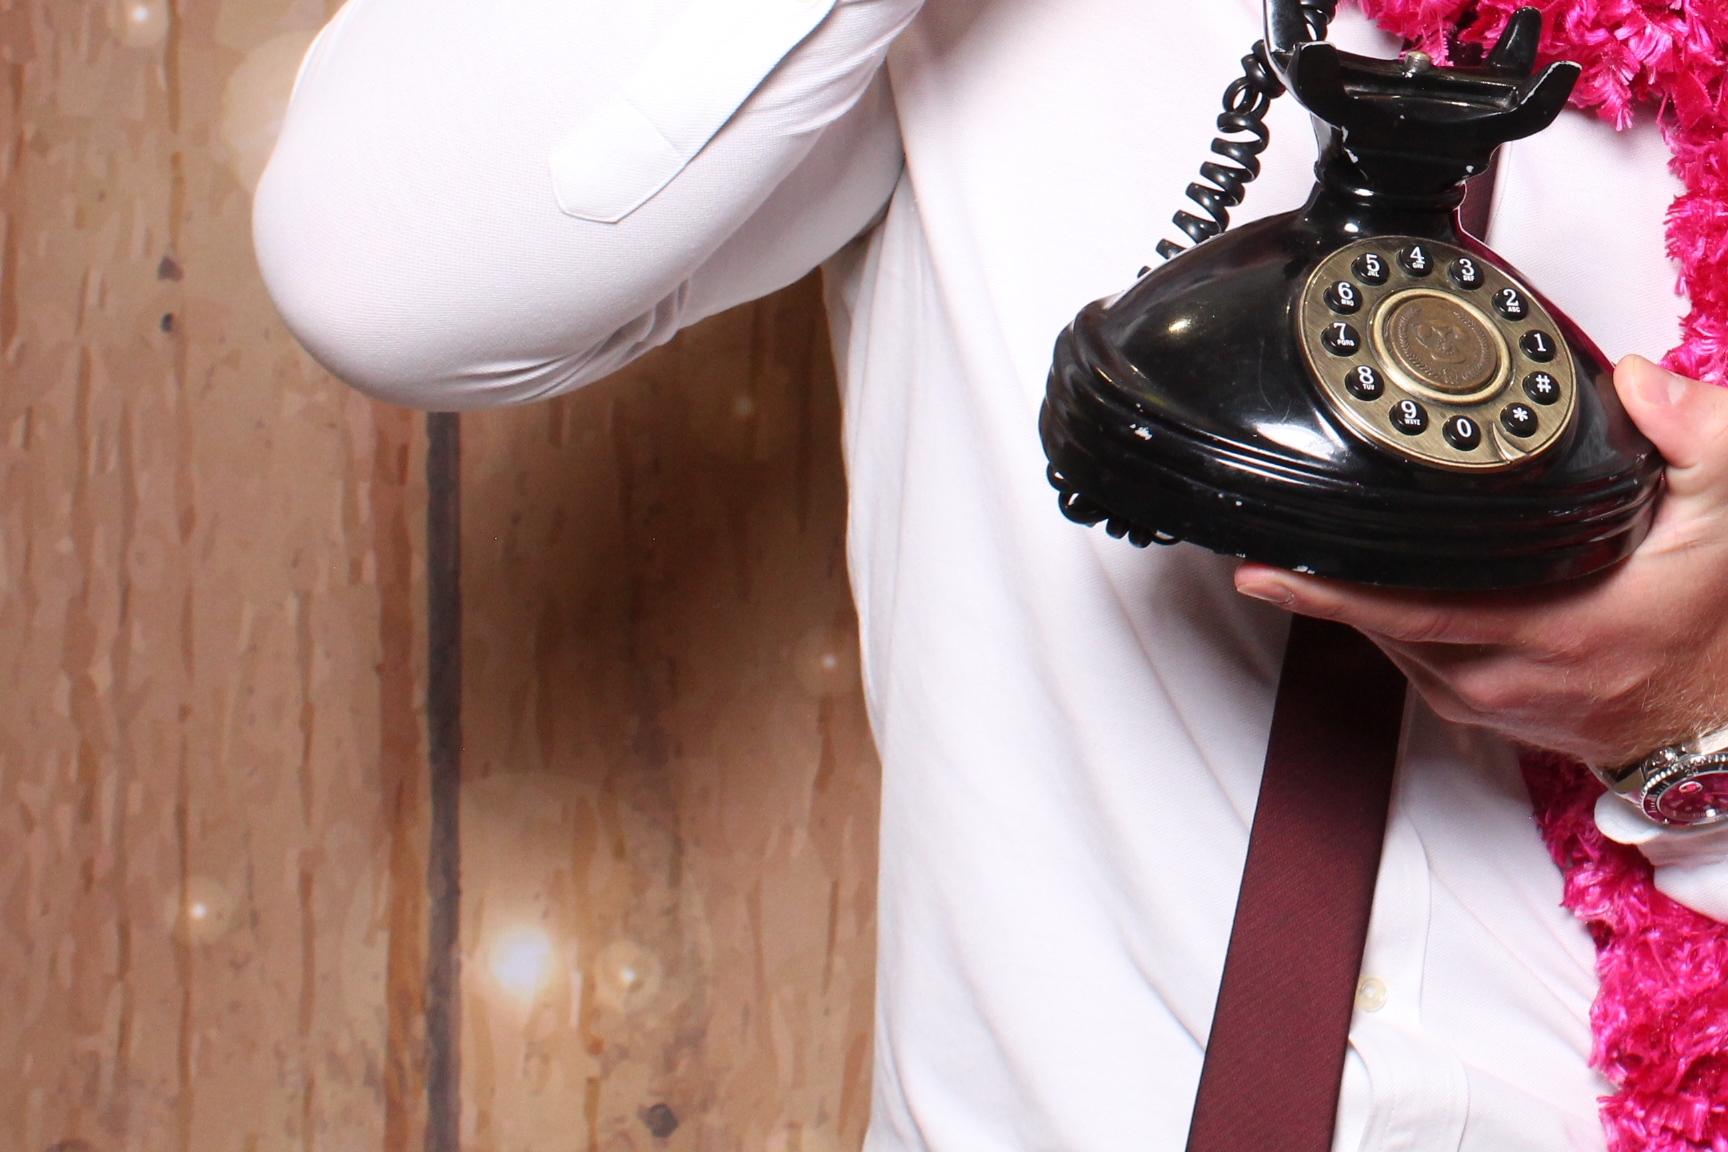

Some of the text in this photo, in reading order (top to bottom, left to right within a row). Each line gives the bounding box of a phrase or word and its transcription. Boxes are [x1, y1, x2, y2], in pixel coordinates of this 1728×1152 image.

[1365, 253, 1381, 272] 5
[1409, 246, 1426, 264] 4
[1459, 258, 1475, 276] 3
[1463, 274, 1475, 282] DEF
[1337, 281, 1353, 300] 6
[1503, 288, 1519, 307] 2
[1333, 322, 1347, 340] 7
[1534, 333, 1547, 352] 1
[1357, 365, 1375, 384] 8
[1363, 383, 1375, 391] TUV
[1401, 400, 1417, 419] 9
[1456, 418, 1472, 438] 0
